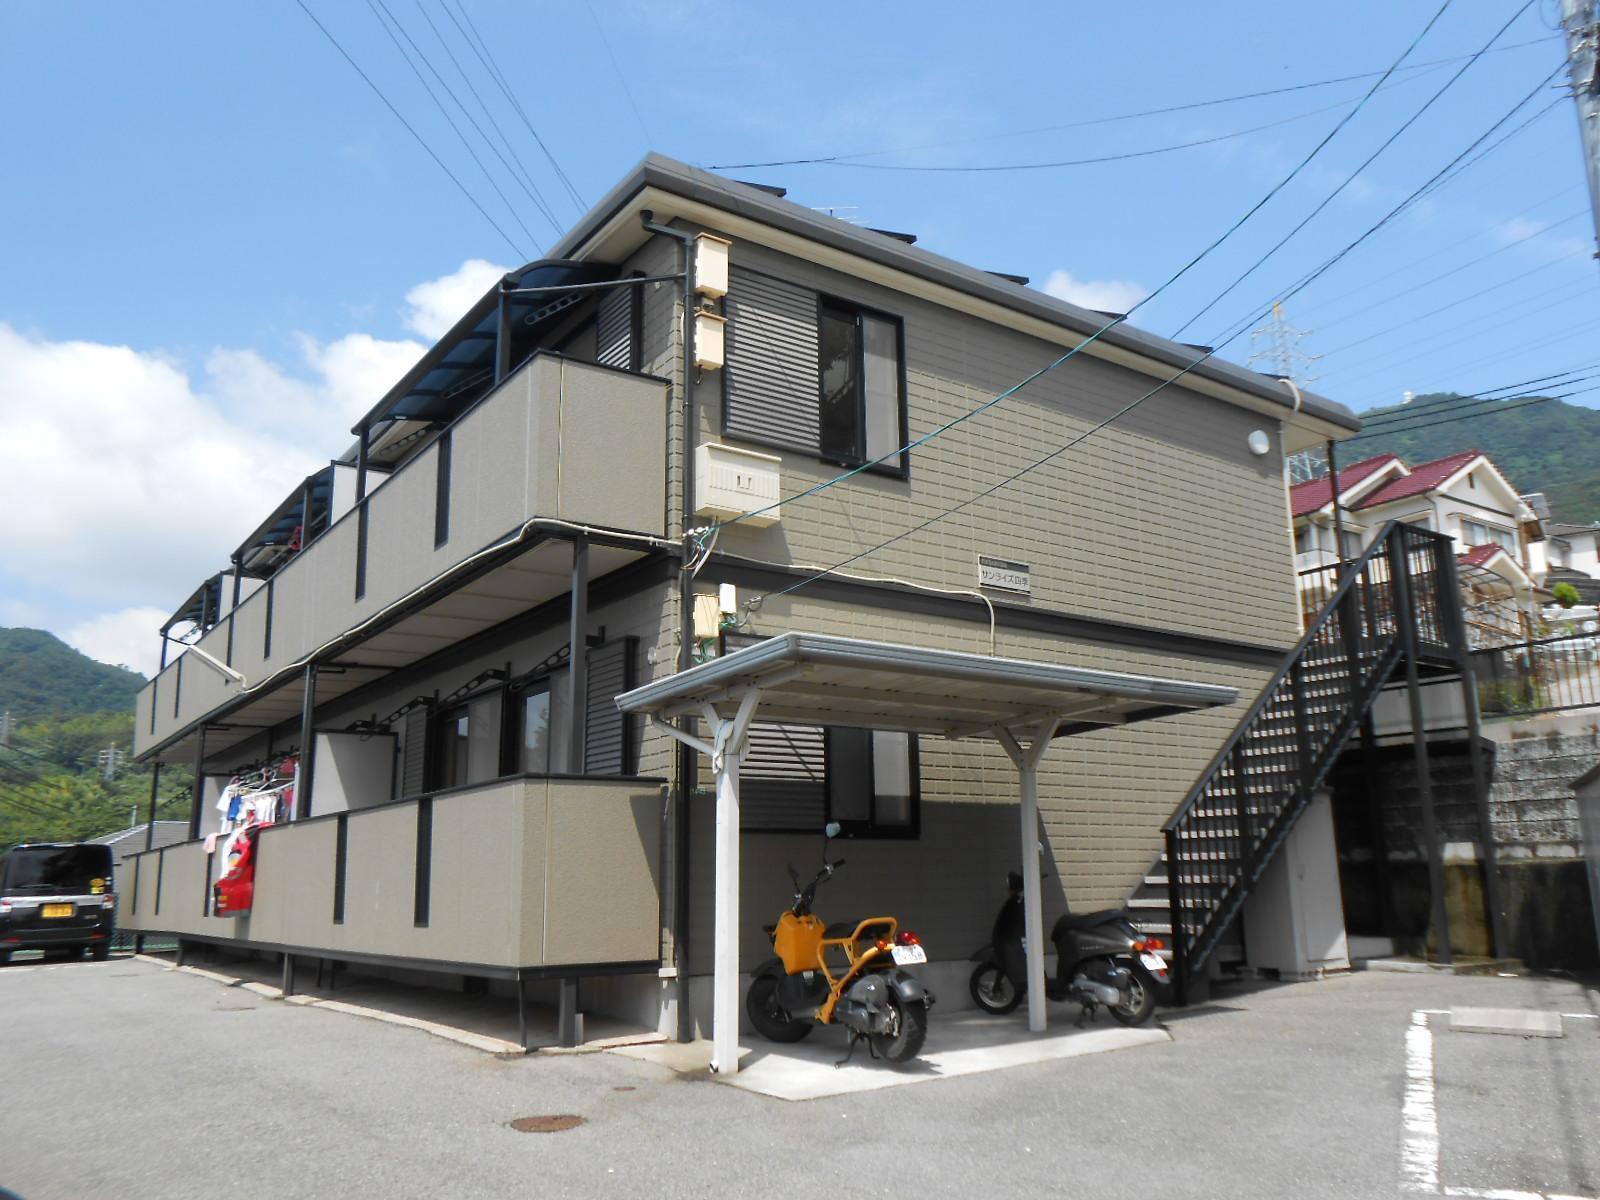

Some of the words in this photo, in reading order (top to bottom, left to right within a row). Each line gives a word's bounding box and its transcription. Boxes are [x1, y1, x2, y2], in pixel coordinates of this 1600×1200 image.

[982, 569, 1029, 586] サンライズ四季
